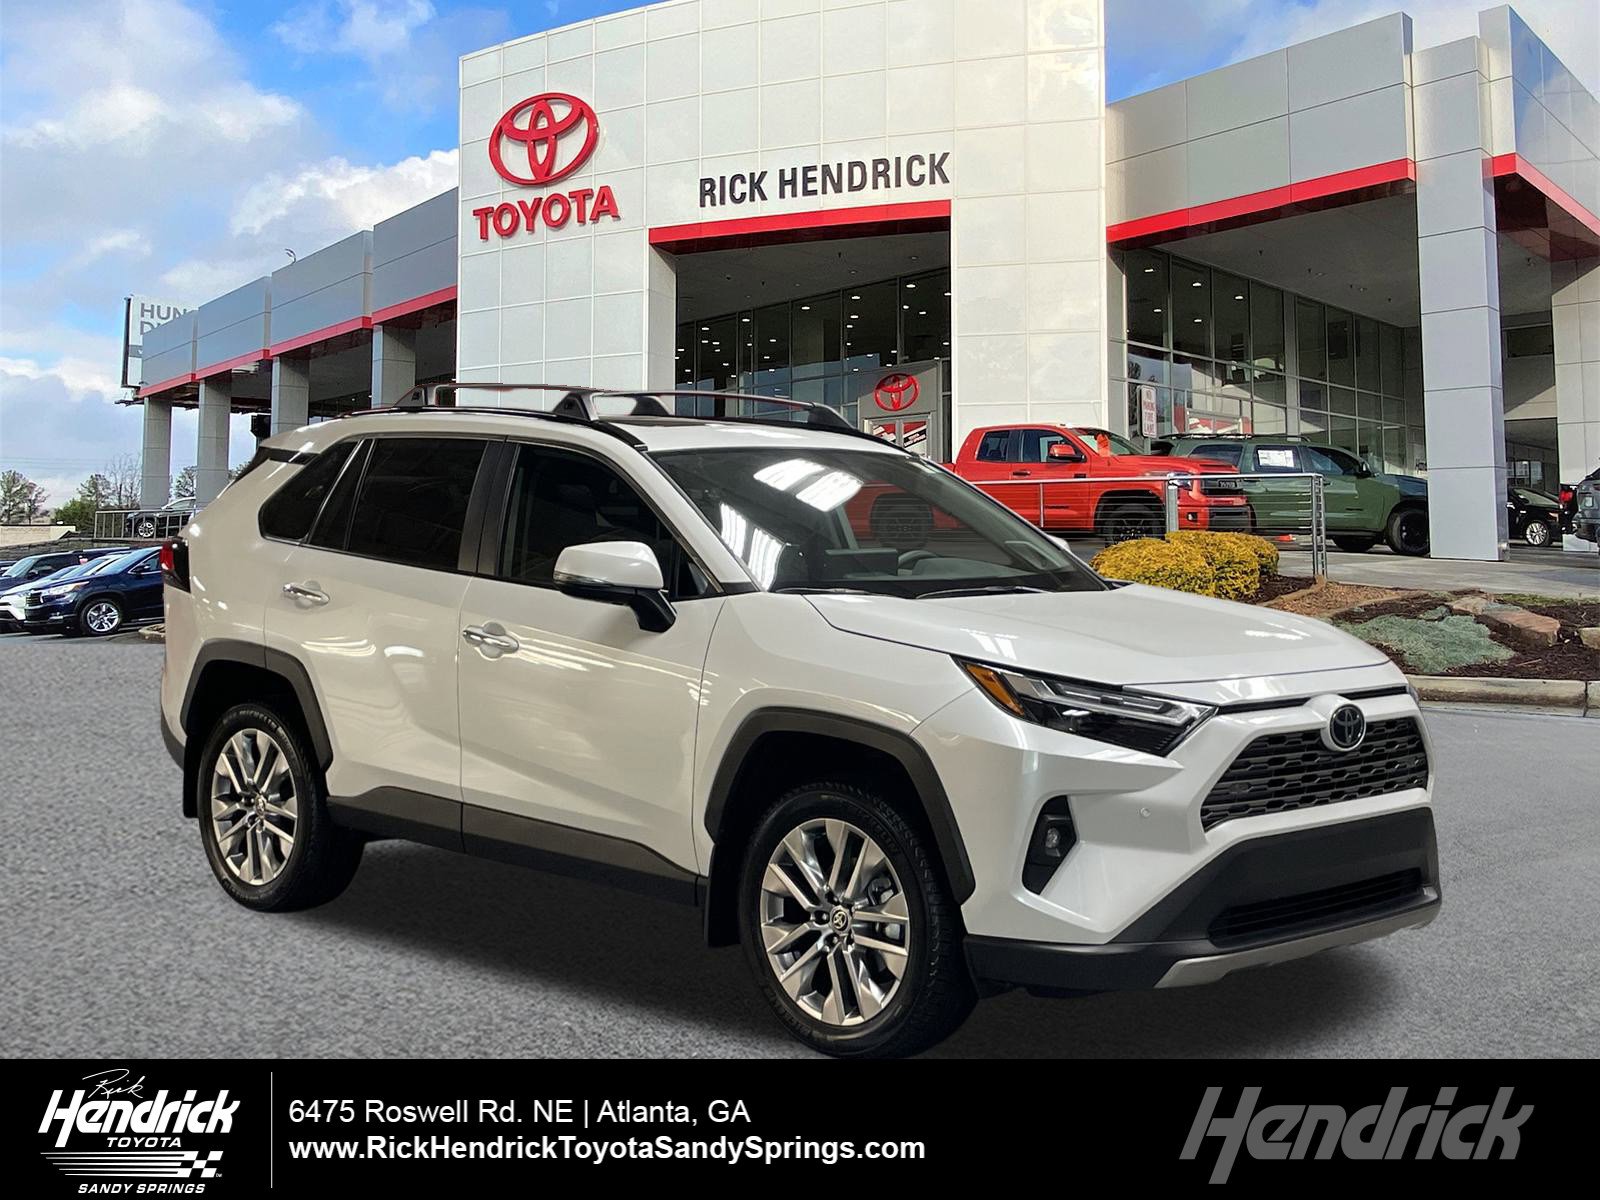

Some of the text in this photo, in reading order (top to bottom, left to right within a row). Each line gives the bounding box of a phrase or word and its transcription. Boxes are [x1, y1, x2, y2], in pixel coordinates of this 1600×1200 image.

[699, 152, 951, 208] RICK HENDRICK
[472, 185, 620, 241] TOYOTA
